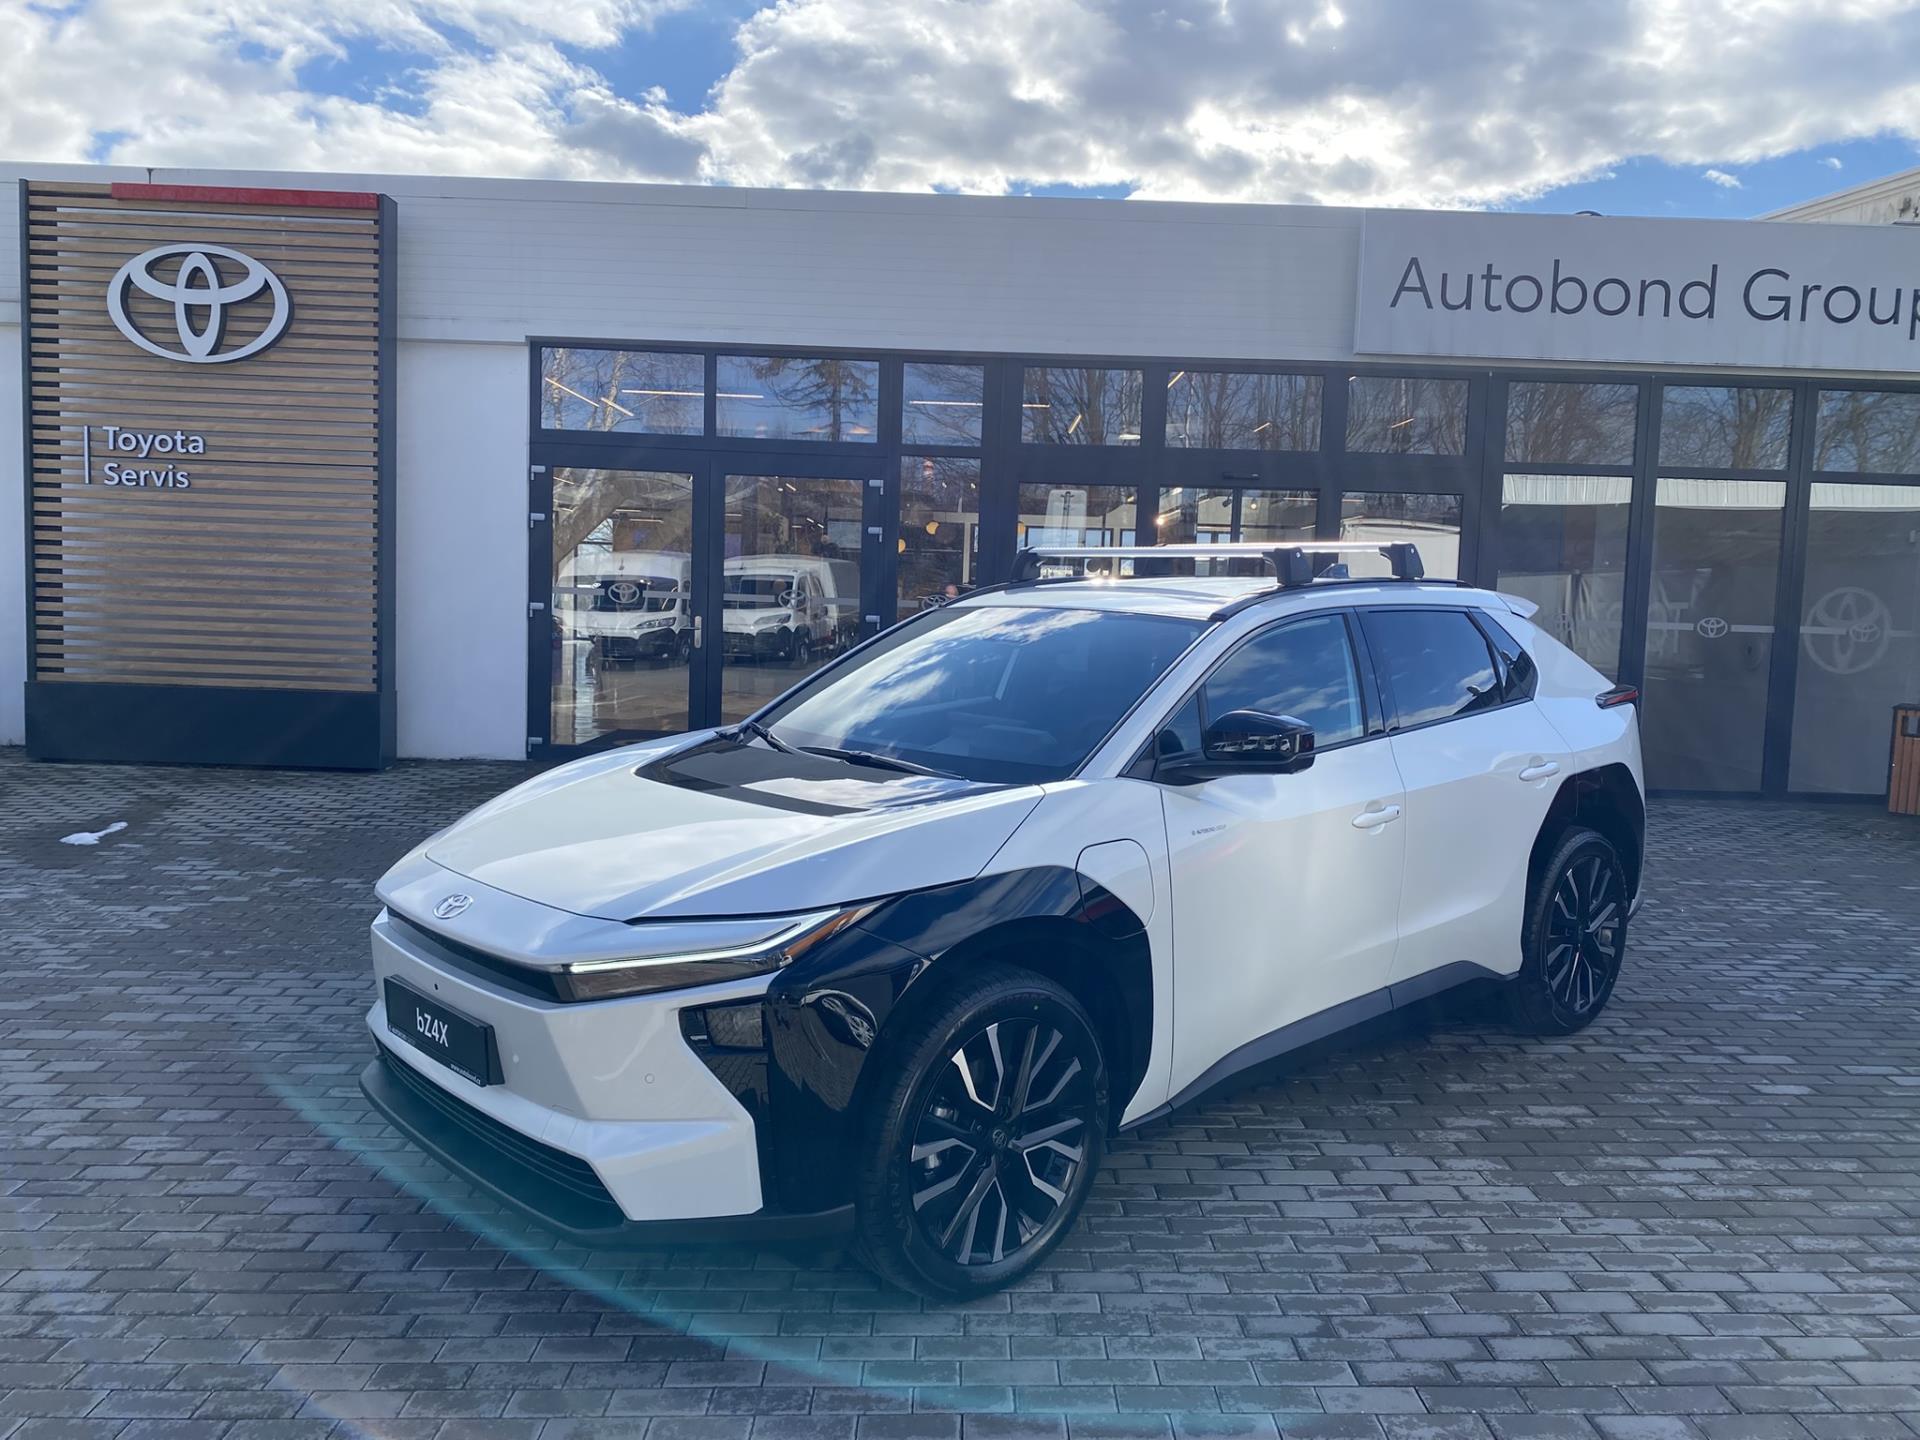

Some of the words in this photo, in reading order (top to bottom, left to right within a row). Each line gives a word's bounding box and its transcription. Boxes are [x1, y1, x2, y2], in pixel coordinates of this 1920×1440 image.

[1390, 256, 1718, 320] Autobond
[1743, 268, 1920, 341] Grou
[102, 426, 206, 458] Toyota
[103, 462, 191, 489] Servis
[416, 1007, 449, 1048] bZ4X
